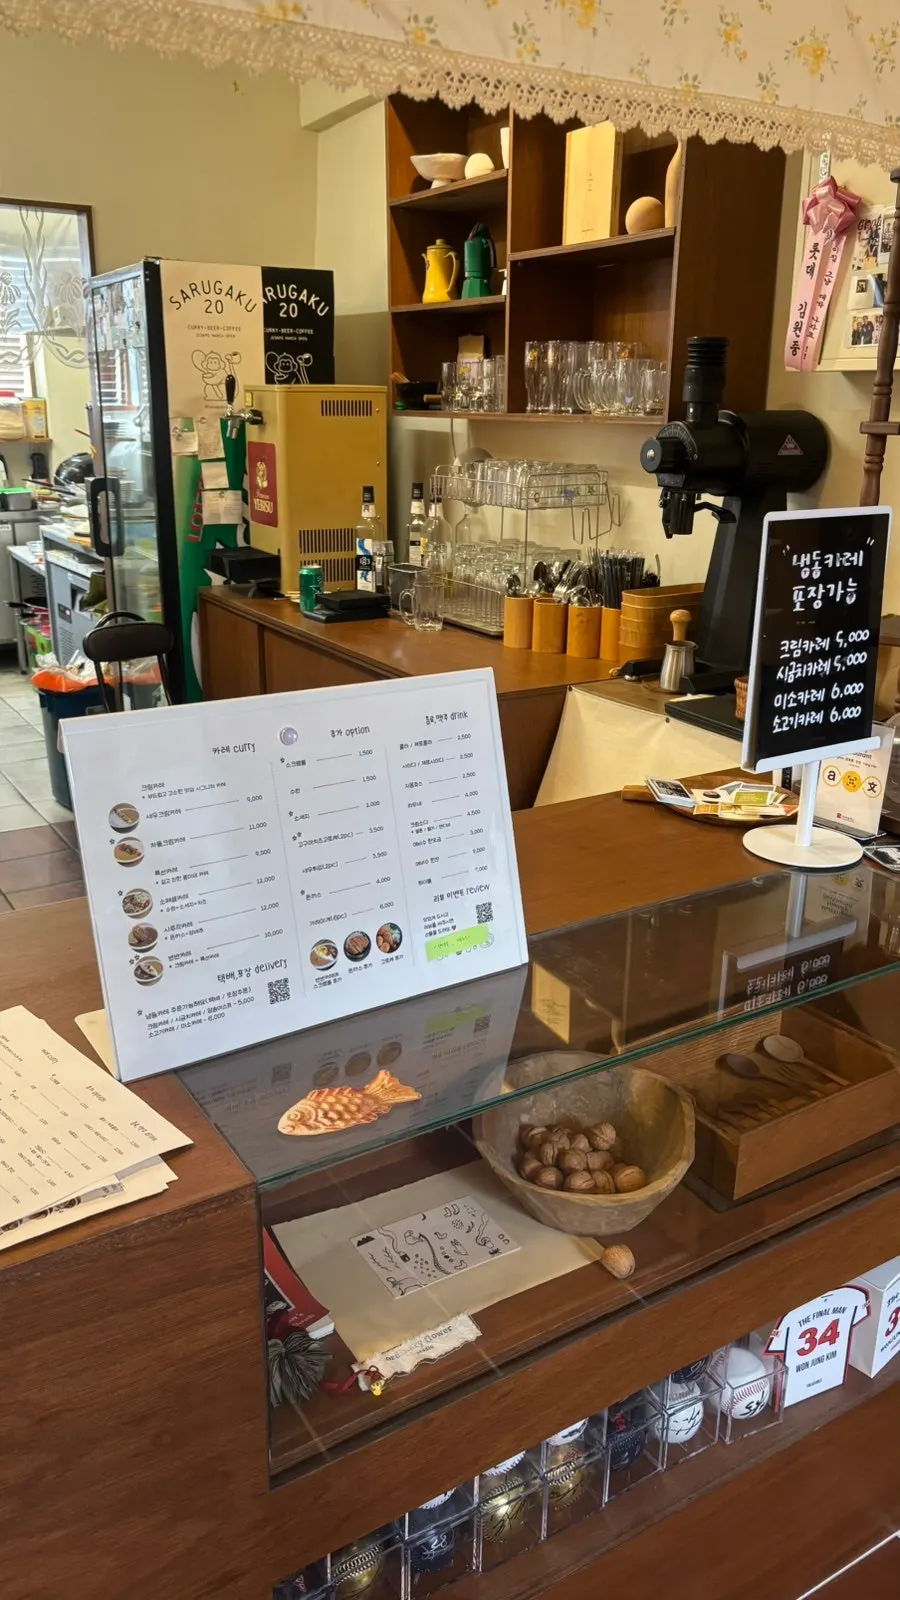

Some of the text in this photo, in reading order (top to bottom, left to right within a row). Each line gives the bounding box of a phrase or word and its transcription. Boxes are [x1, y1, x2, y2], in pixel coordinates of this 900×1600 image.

[168, 279, 257, 313] SARUGAKU
[262, 284, 329, 317] RUGAKU
[204, 299, 224, 315] 20
[279, 302, 298, 318] 20
[790, 301, 807, 357] 김원중
[792, 550, 864, 580] 냉동카레
[792, 577, 858, 612] 포장가능
[780, 629, 870, 660] 크림카레 5,000
[776, 651, 868, 684] 시금치카레 5,000
[774, 682, 864, 710] 미소카레 6,000
[450, 710, 468, 721] drink
[772, 706, 862, 734] 소고기카레 6,000
[345, 726, 370, 738] option
[212, 742, 256, 754] 카레 curry
[246, 794, 263, 803] 9,000
[464, 790, 478, 798] 4,000
[248, 822, 268, 831] 11,000
[368, 826, 384, 834] 3,500
[255, 848, 272, 857] 9,000
[256, 875, 276, 885] 12,000
[376, 876, 391, 885] 4,000
[446, 888, 464, 899] 이벤트
[466, 884, 490, 896] review
[260, 902, 280, 912] 12,000
[264, 928, 284, 938] 10,000
[217, 958, 288, 984] 택배,포장 delivery
[237, 996, 255, 1006] 5,000
[208, 1012, 226, 1022] 6,000
[797, 1306, 848, 1328] THE FINAL MAN
[424, 1324, 453, 1344] flower
[796, 1317, 840, 1356] 34
[796, 1350, 838, 1374] WON JUNG KIM
